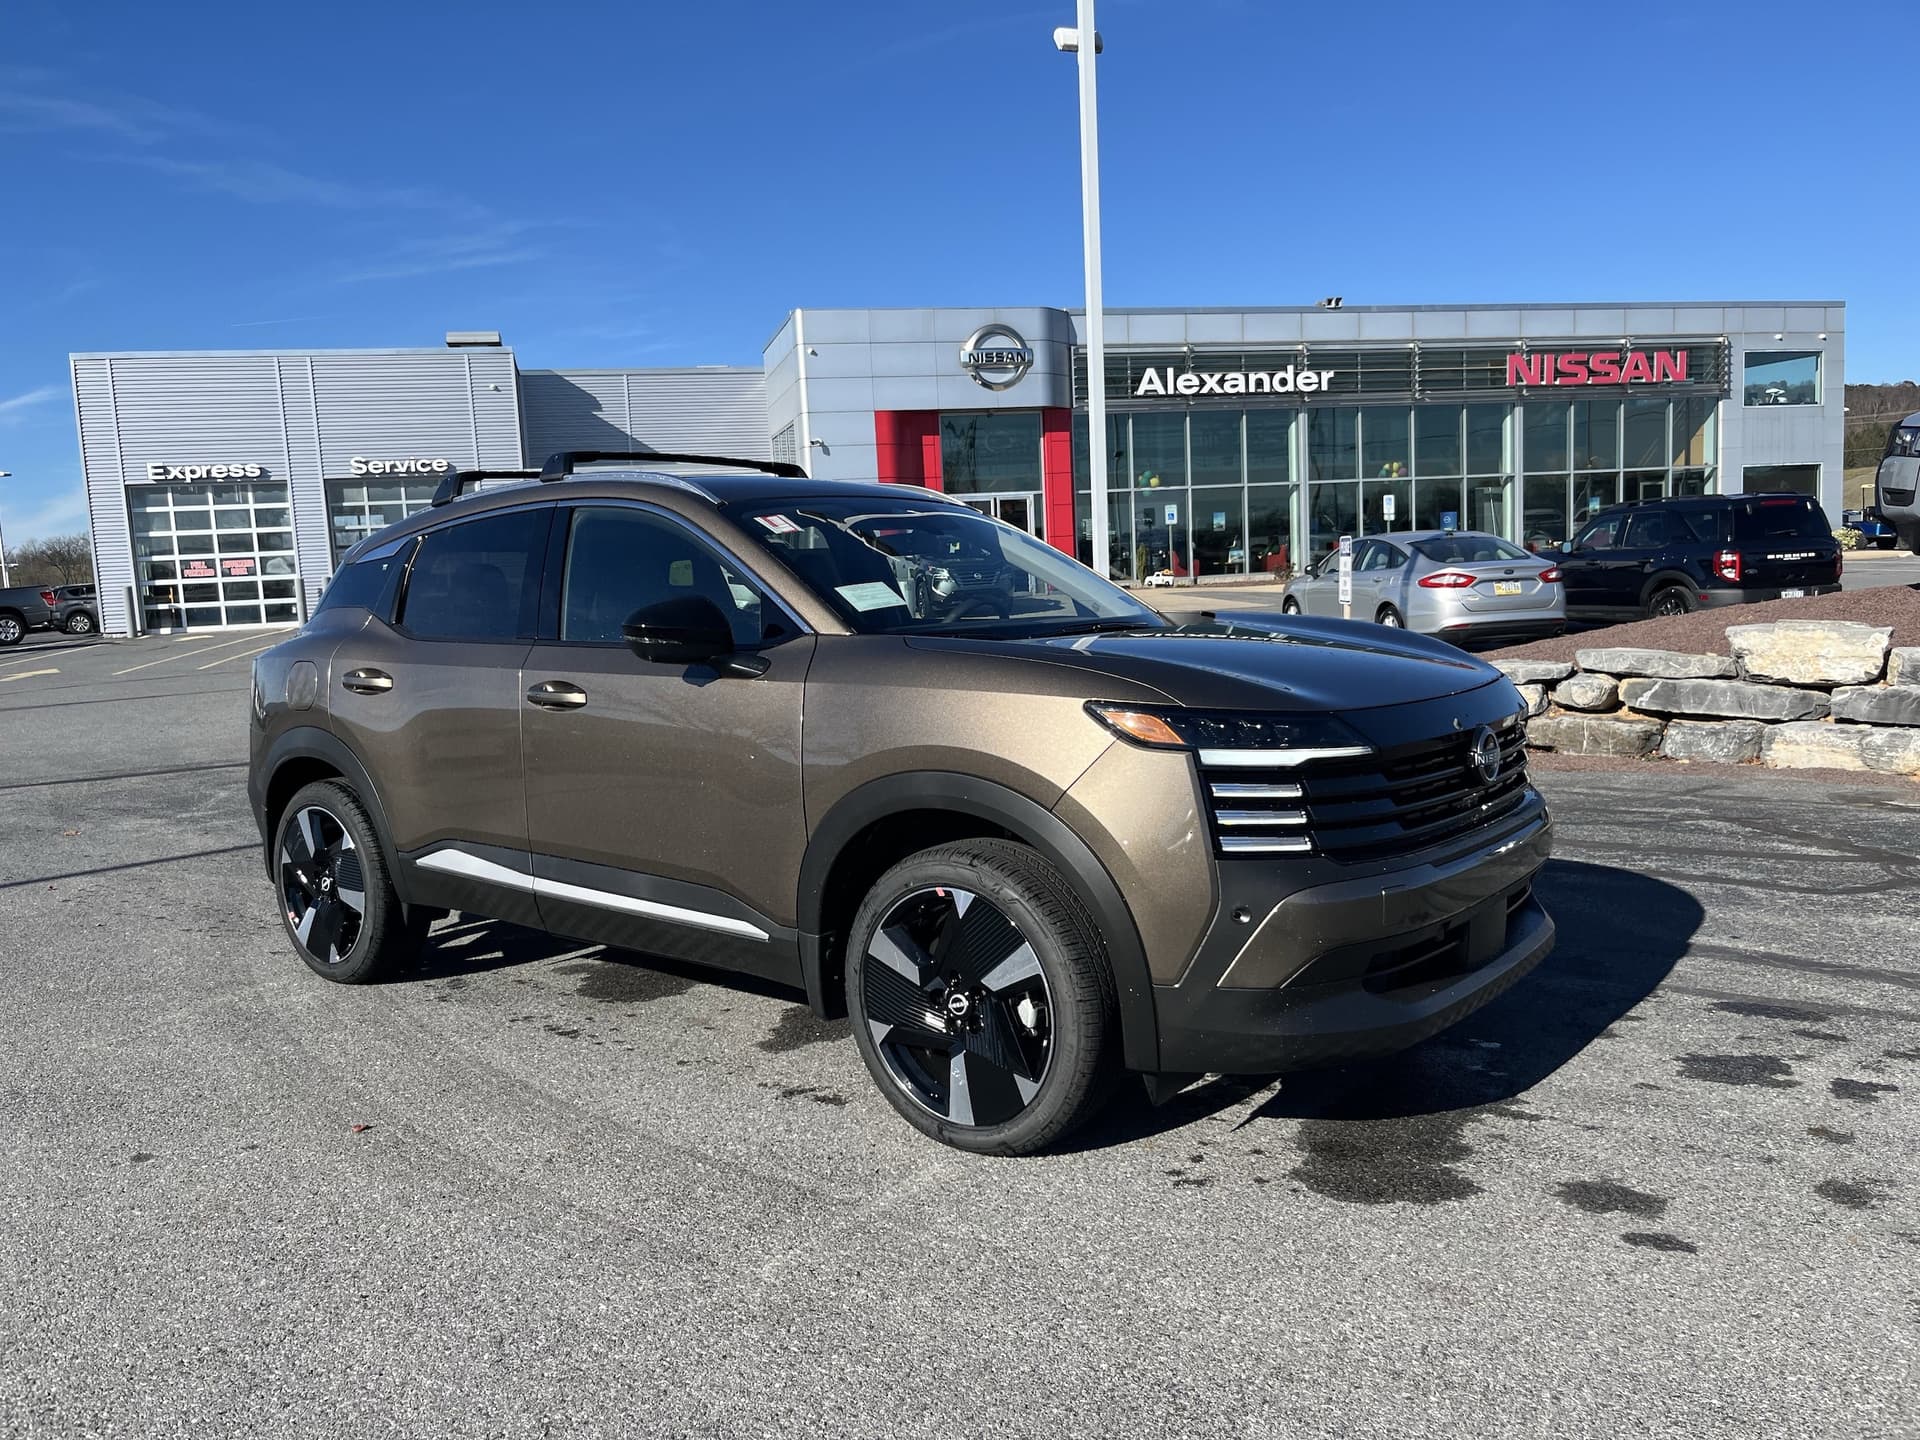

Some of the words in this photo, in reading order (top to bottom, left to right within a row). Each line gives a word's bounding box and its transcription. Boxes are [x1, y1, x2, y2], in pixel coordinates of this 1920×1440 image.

[968, 351, 1027, 364] NISSAN
[1506, 351, 1688, 386] NISSAN
[1135, 366, 1334, 396] Alexander
[146, 462, 261, 483] Express
[350, 456, 449, 475] Service
